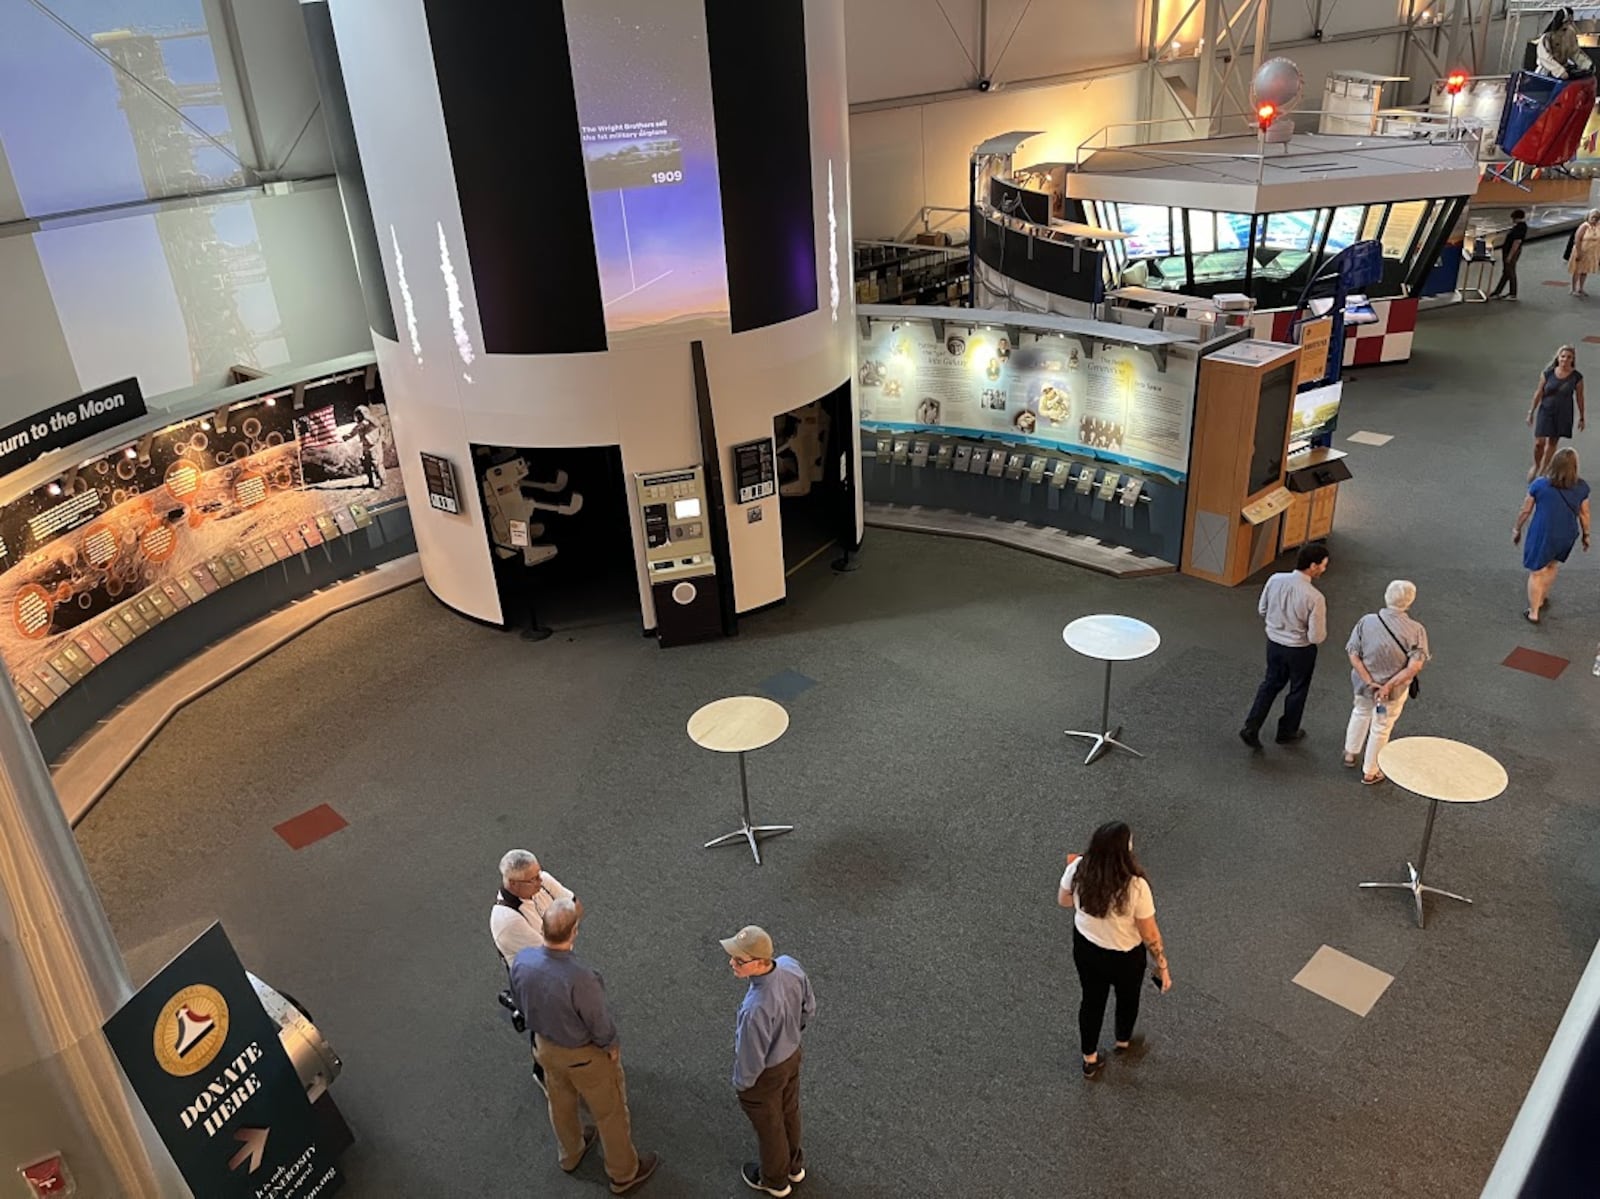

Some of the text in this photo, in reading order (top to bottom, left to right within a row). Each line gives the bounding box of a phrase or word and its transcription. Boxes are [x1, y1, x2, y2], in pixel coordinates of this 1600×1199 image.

[598, 124, 623, 133] Wright
[624, 122, 655, 131] Brothers
[609, 131, 637, 139] military
[651, 170, 683, 184] 1909
[0, 394, 125, 457] turn to the Moon
[180, 1041, 264, 1129] DONATE
[203, 1073, 262, 1137] HERE
[264, 1143, 316, 1199] ENEROSITY
